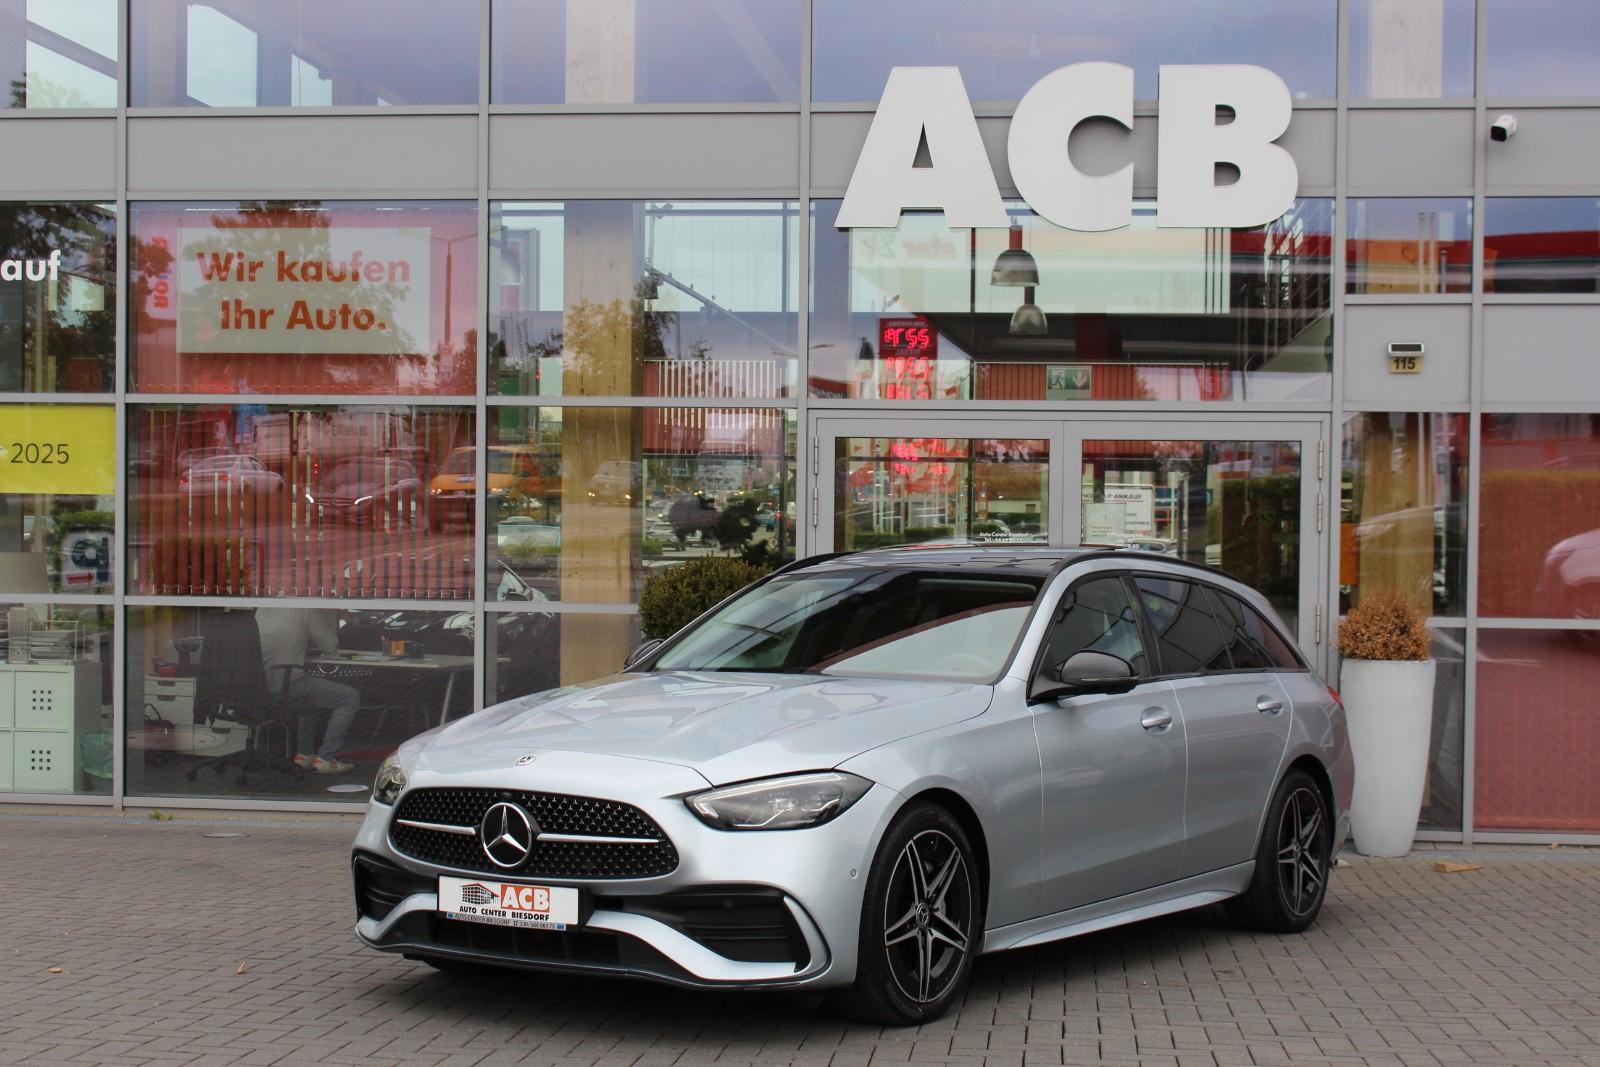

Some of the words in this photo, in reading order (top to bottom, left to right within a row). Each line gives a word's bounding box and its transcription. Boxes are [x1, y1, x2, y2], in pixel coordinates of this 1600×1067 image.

[834, 61, 1299, 232] ACB
[0, 249, 61, 282] auf
[196, 251, 264, 283] Wir
[277, 250, 410, 283] kaufen
[221, 299, 275, 331] Ihr
[286, 300, 387, 331] Auto.
[1393, 356, 1417, 370] 115
[11, 442, 70, 464] 2025
[502, 886, 549, 911] ACB
[459, 905, 477, 914] AUTO
[481, 908, 507, 917] CENTER
[511, 911, 550, 921] BIESDORF
